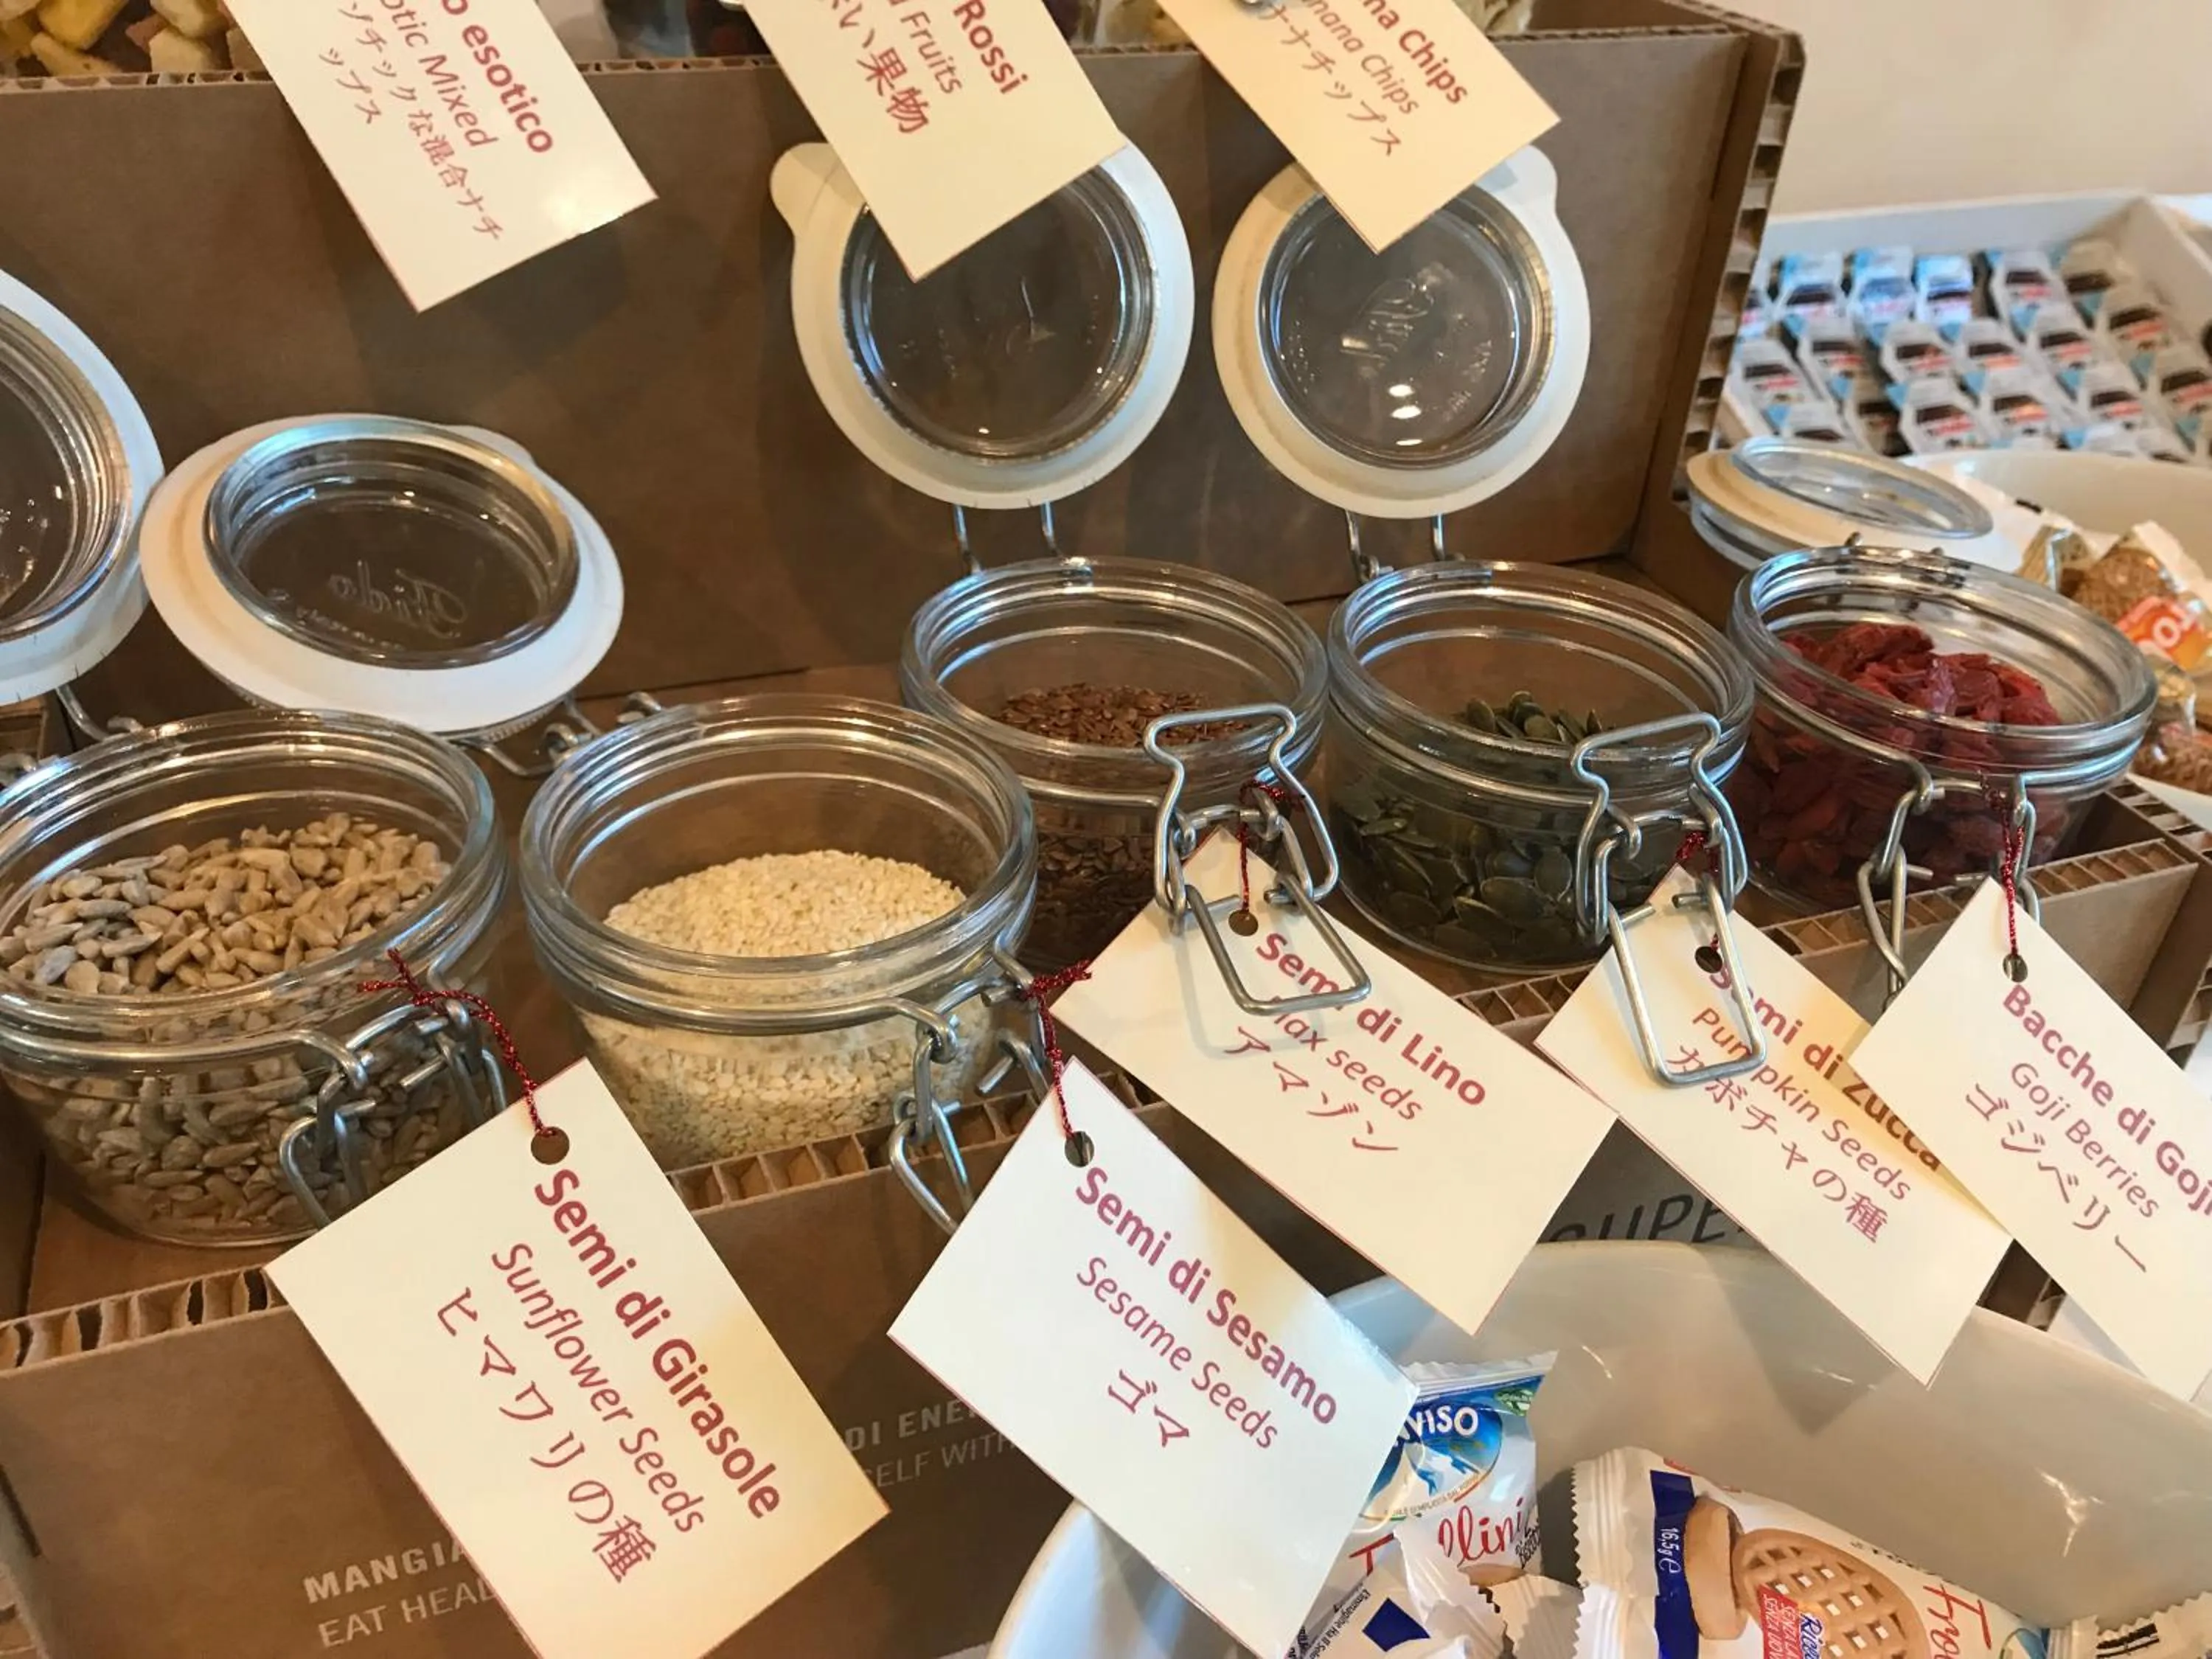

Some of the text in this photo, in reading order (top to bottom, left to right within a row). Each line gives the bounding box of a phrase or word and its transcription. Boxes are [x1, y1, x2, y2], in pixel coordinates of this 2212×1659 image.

[418, 55, 498, 147] Mixed
[462, 24, 553, 153] esotico
[832, 0, 929, 133] い果物
[900, 11, 962, 94] Fruits
[953, 0, 1029, 94] Rossi
[1360, 54, 1419, 115] Chips
[1399, 29, 1468, 104] Chips
[1256, 933, 1486, 1106] Sem di Lino
[1326, 1046, 1423, 1121] seeds
[1709, 963, 1941, 1172] Smi di Zucca
[2002, 985, 2115, 1107] Bacche
[2117, 1097, 2155, 1147] di
[1222, 1026, 1399, 1152] アマゾン
[2011, 1062, 2160, 1219] Goji Berries
[1548, 1193, 1745, 1243] UPE
[1821, 1119, 1911, 1201] Seeds
[1965, 1082, 2147, 1273] ゴジベリー
[534, 1169, 781, 1520] Semi di Girasole
[1076, 1167, 1337, 1425] Semi di Sesamo
[1077, 1256, 1279, 1450] Sesame Seeds
[437, 1287, 658, 1583] ヒマワリの種
[491, 1242, 705, 1534] Sunflower Seeds
[844, 1421, 880, 1451] DI
[898, 1399, 977, 1438] ENE
[1107, 1369, 1191, 1447] ゴマ
[319, 1606, 387, 1649] EAT
[400, 1576, 499, 1623] HEAL
[865, 1450, 932, 1486] ELF
